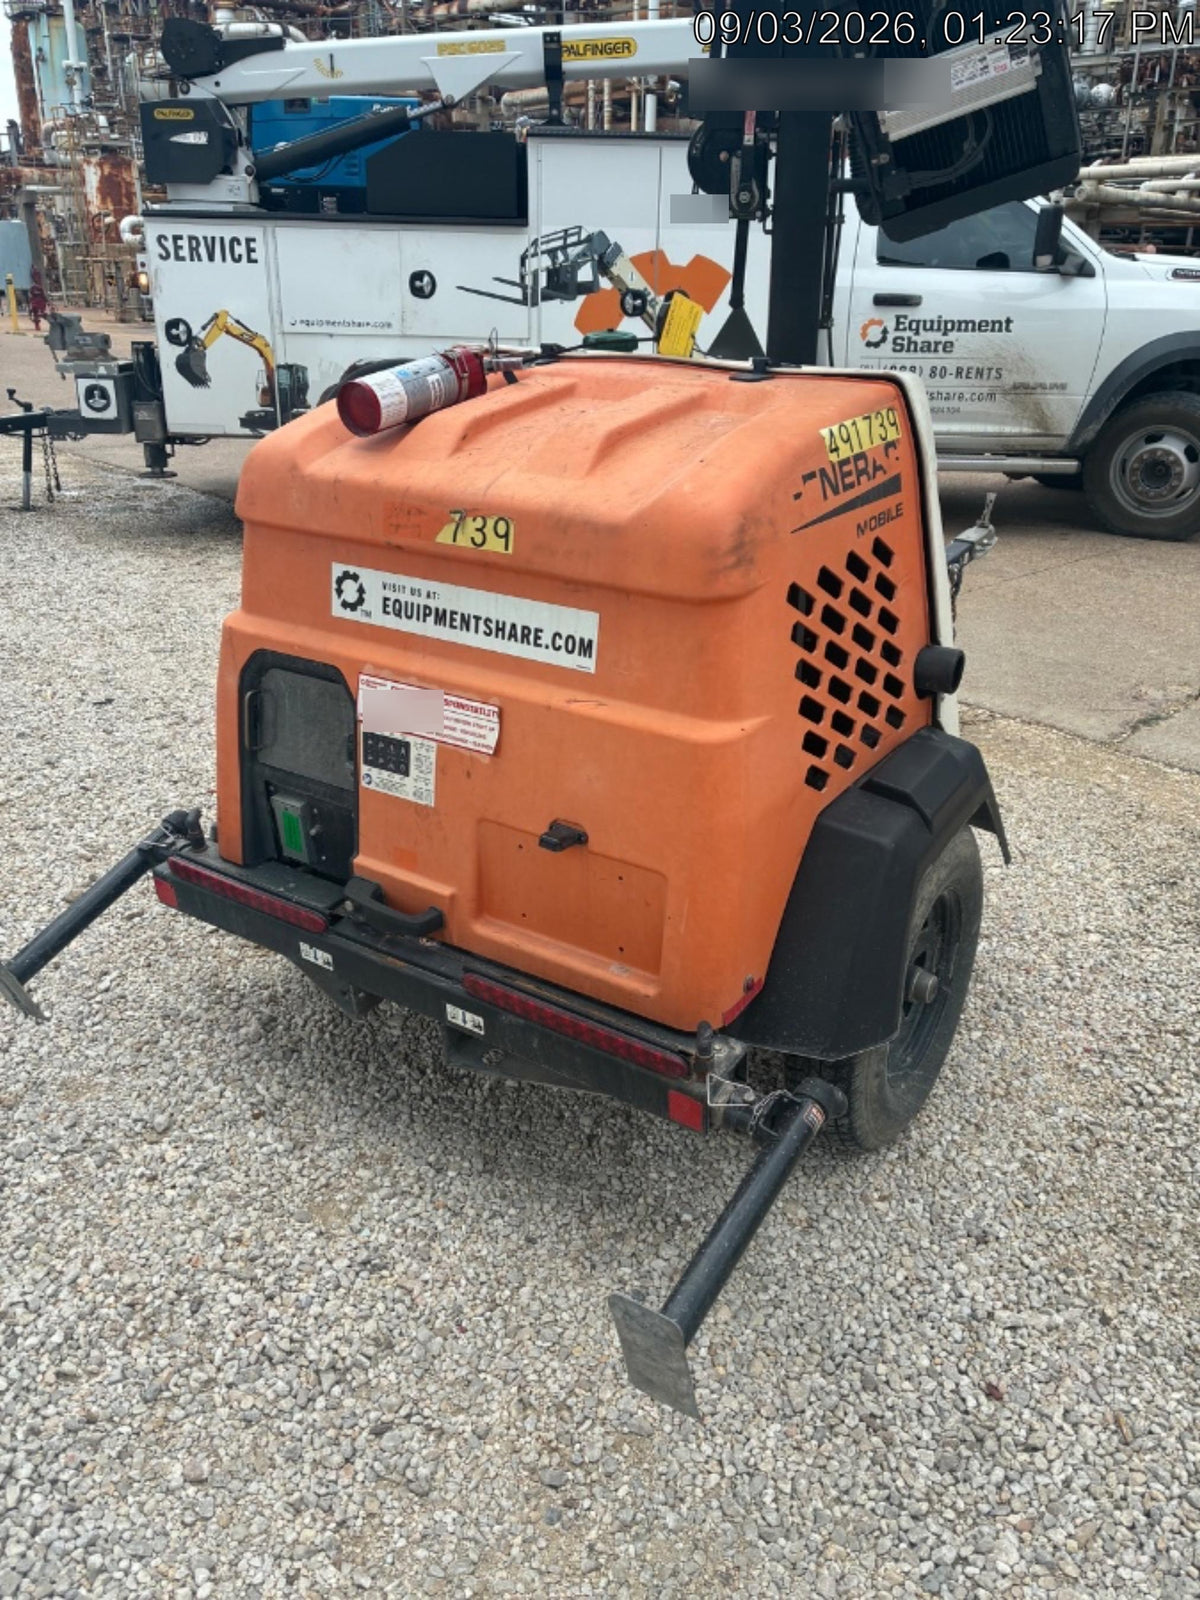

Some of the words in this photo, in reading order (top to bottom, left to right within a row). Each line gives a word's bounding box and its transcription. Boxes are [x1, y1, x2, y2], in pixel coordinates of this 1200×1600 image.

[562, 40, 633, 58] PALFINGER
[156, 234, 259, 264] SERVICE
[893, 315, 1014, 337] Equipment
[892, 336, 954, 354] Share
[929, 366, 1004, 381] 80-RENTS
[926, 390, 997, 403] share.com
[828, 407, 900, 459] 491739
[449, 509, 511, 552] 739
[856, 502, 904, 538] MOBILE
[381, 581, 407, 594] VISIT
[410, 586, 422, 598] US
[426, 589, 440, 601] AT:
[381, 596, 594, 659] EQUIPMENTSHARE.COM
